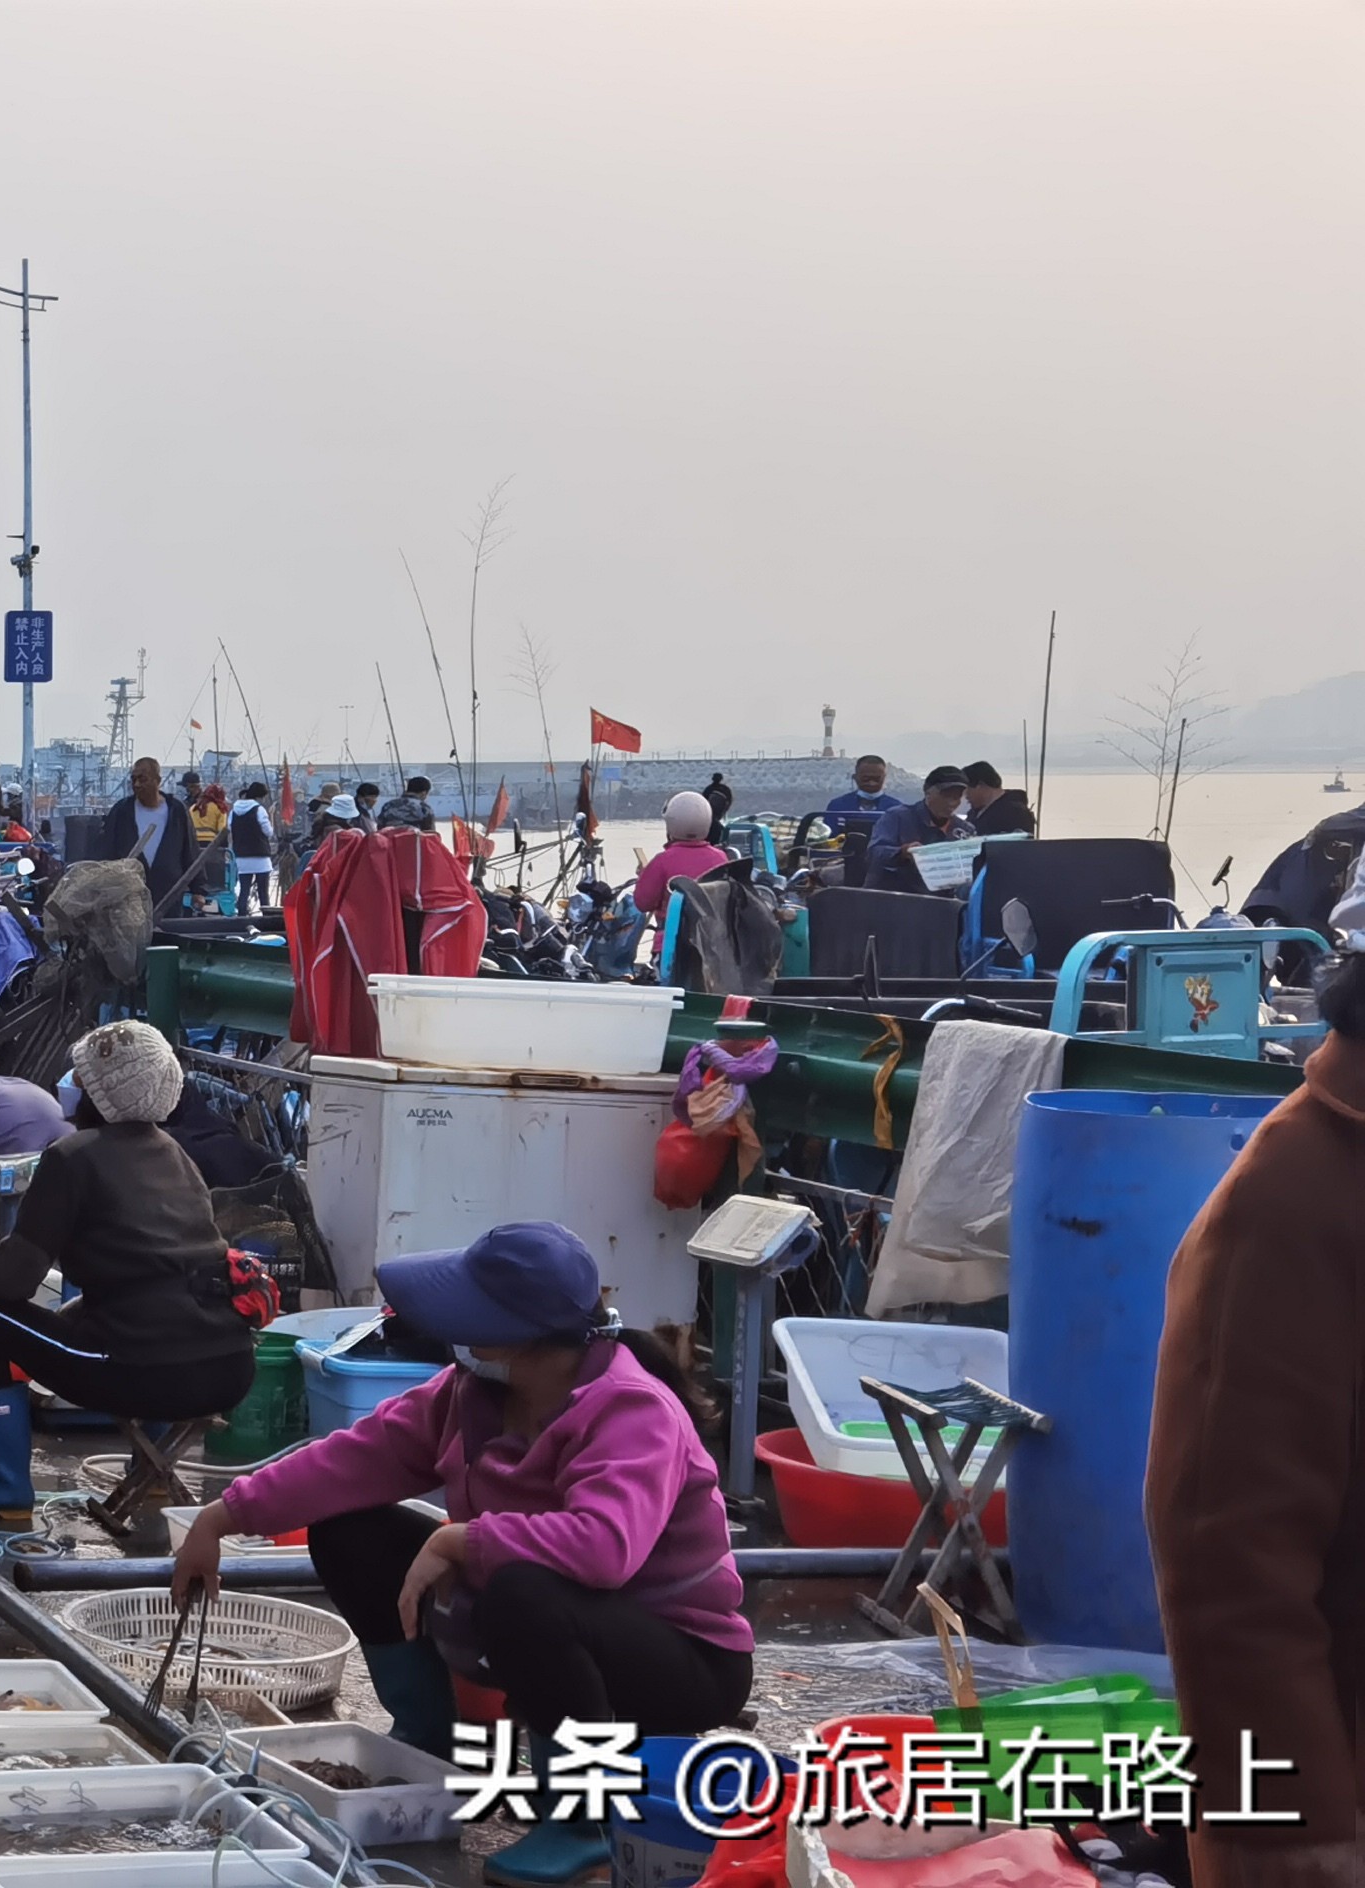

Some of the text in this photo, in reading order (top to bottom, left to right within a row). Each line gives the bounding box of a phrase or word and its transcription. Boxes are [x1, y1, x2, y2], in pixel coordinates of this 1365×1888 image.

[14, 617, 29, 676] 禁止入内
[31, 617, 45, 676] 非生产人员
[406, 1108, 453, 1119] AUCMA
